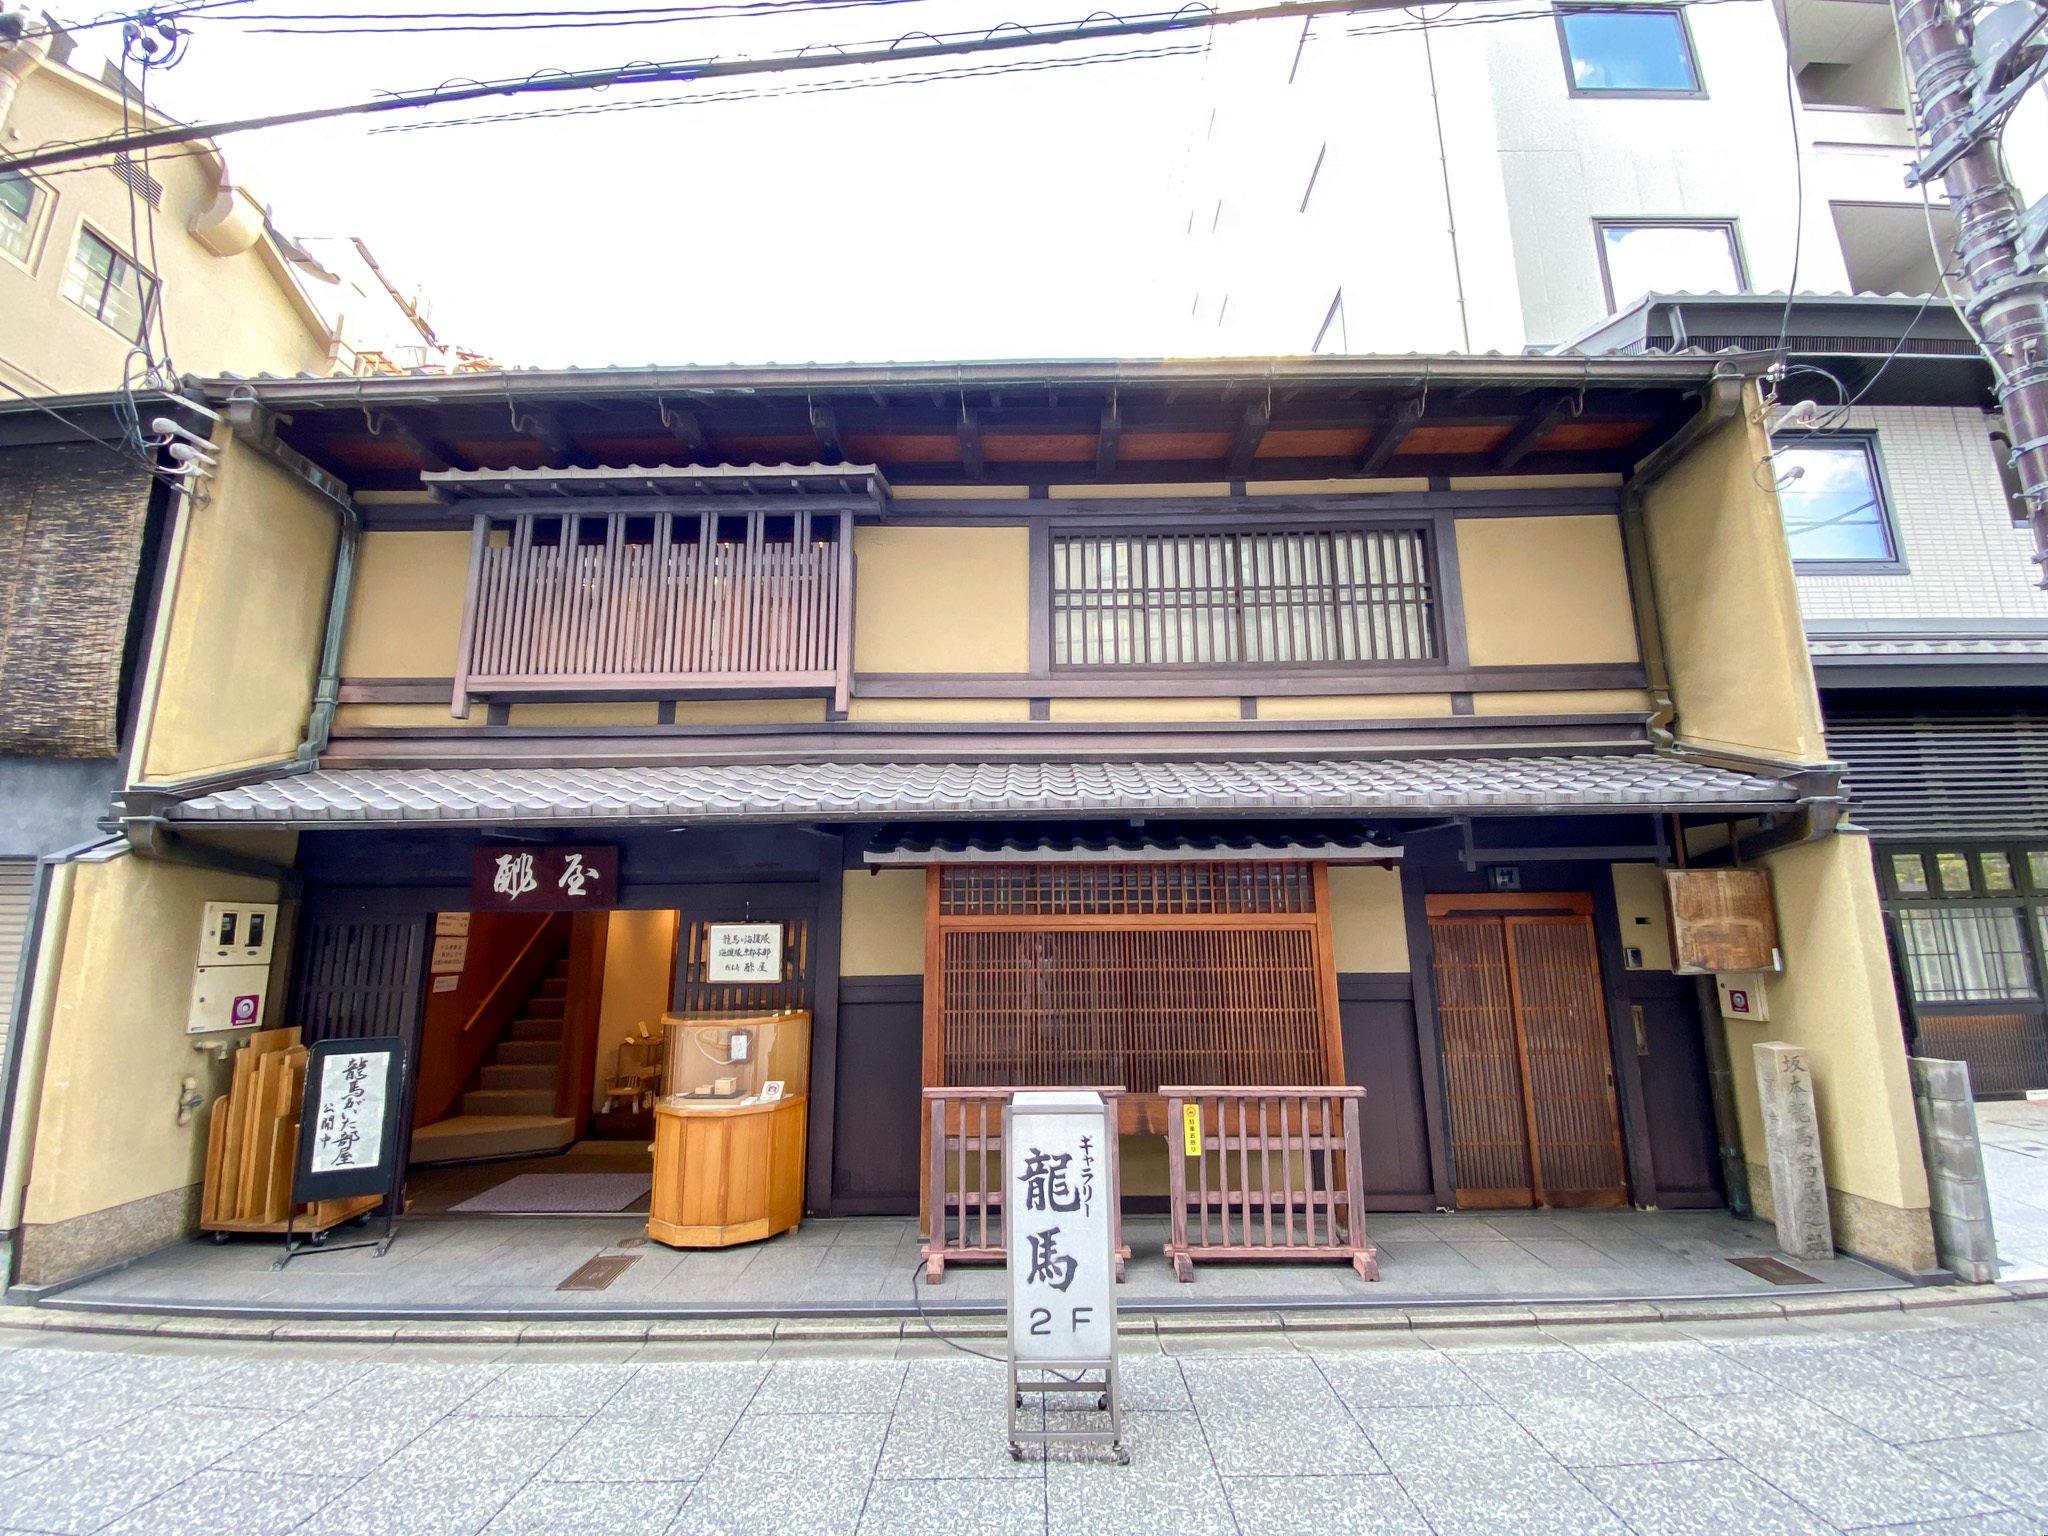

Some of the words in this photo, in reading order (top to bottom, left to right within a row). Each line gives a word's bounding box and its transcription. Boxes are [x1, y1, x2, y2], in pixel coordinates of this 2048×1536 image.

[320, 1102, 336, 1149] 公開中
[331, 1057, 369, 1166] 龍馬がいた部屋
[1016, 1147, 1081, 1293] 龍馬
[1079, 1135, 1095, 1218] ギャラリー
